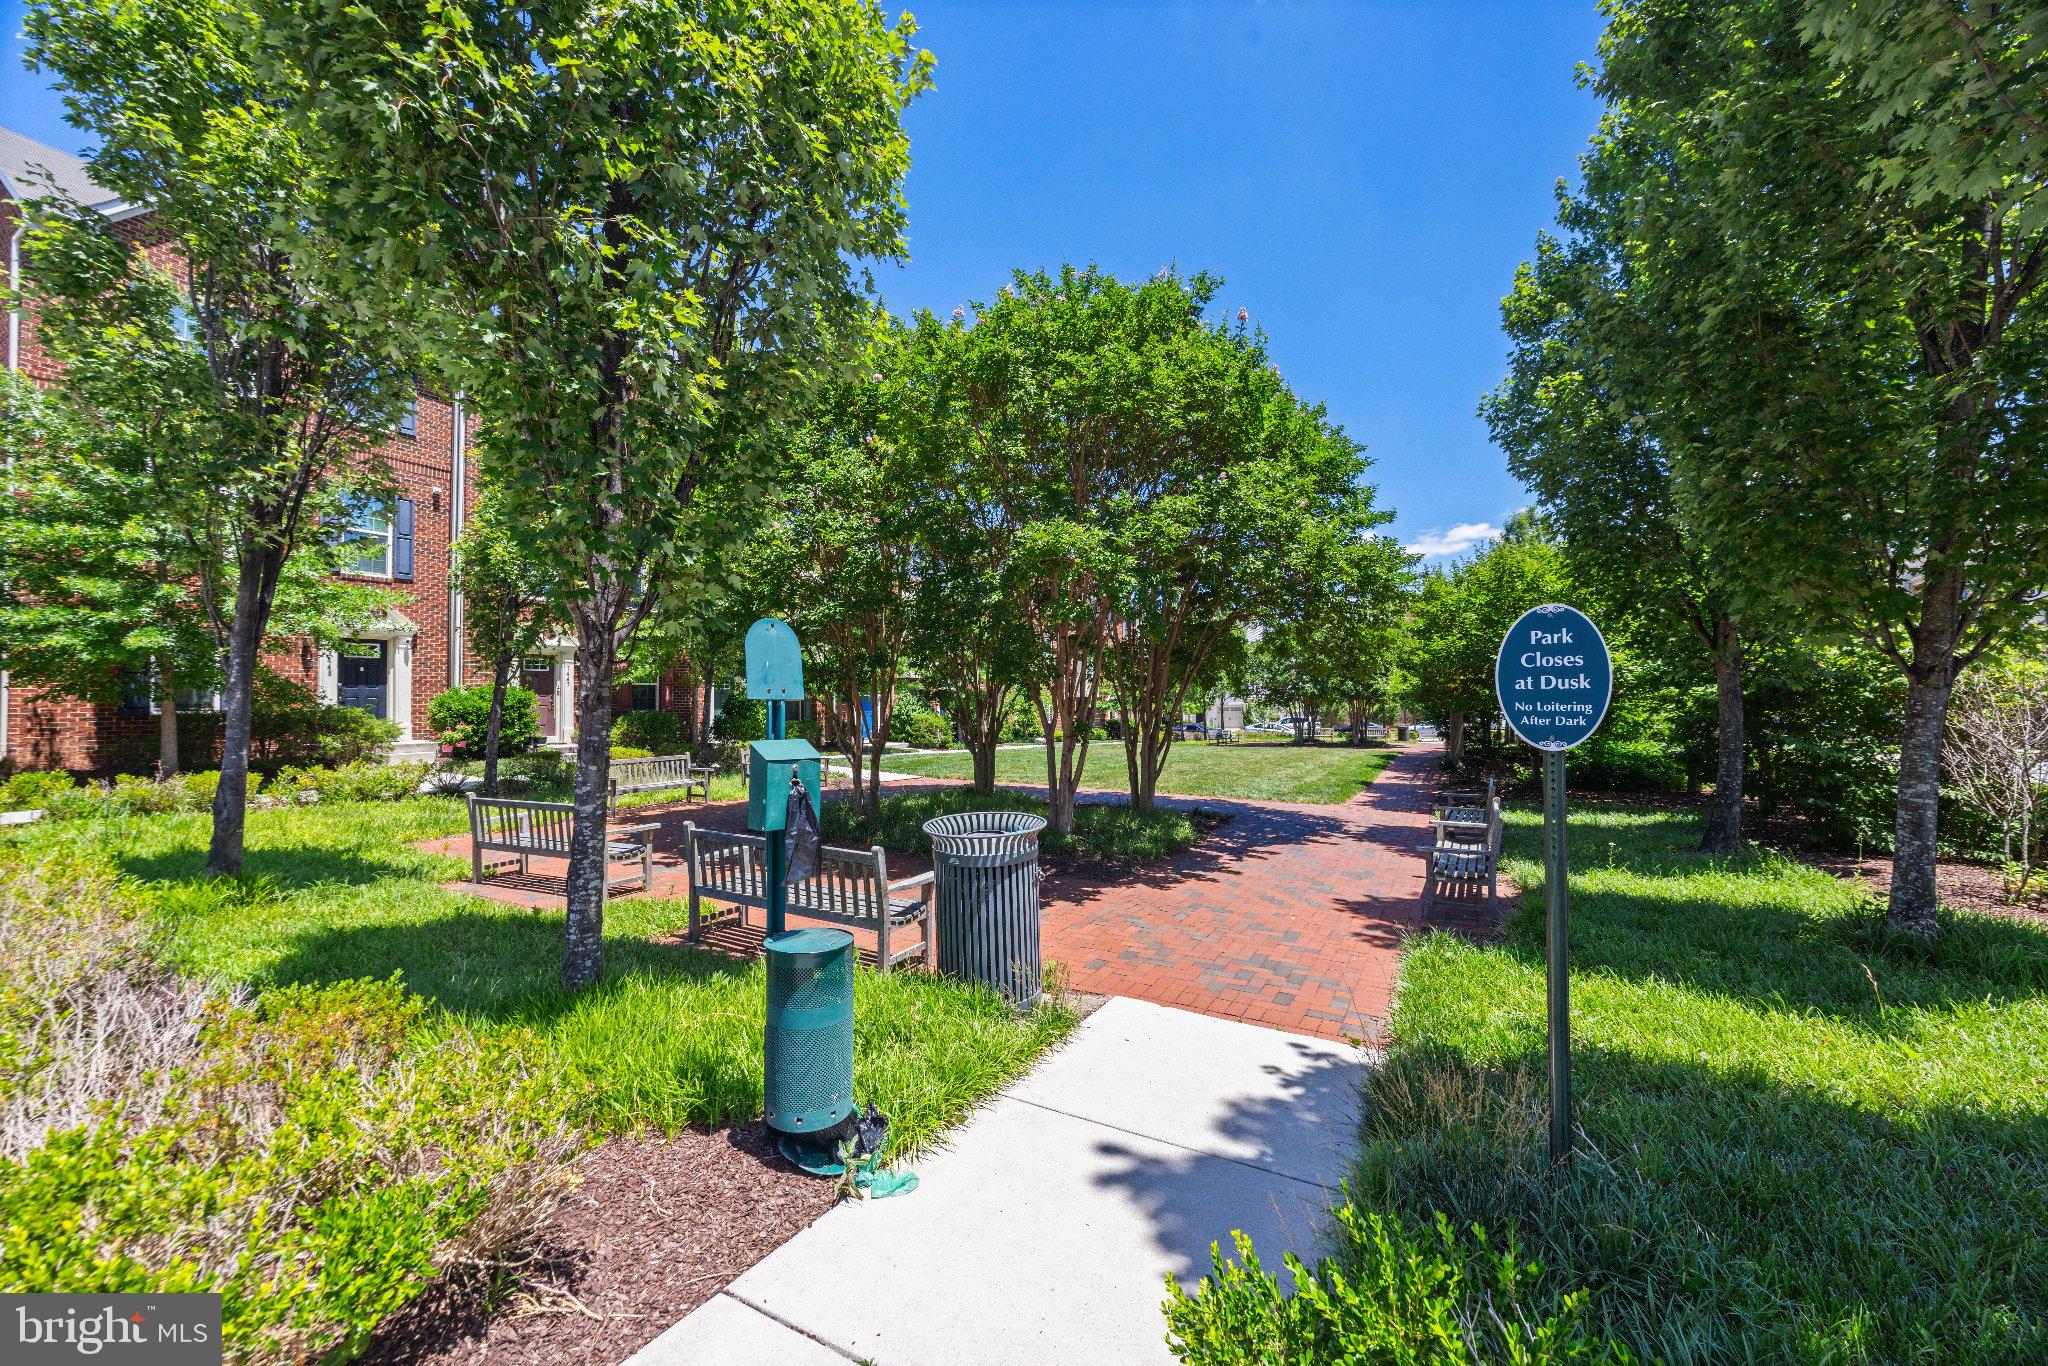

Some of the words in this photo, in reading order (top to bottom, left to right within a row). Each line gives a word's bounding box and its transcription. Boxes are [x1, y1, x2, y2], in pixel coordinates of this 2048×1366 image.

[1531, 628, 1573, 644] Park
[1521, 652, 1583, 667] Closes
[1515, 676, 1533, 690] at
[1540, 674, 1591, 689] Dusk
[1515, 702, 1532, 711] No
[1537, 702, 1593, 714] Loitering
[1521, 716, 1551, 726] After
[1556, 716, 1586, 726] Dark
